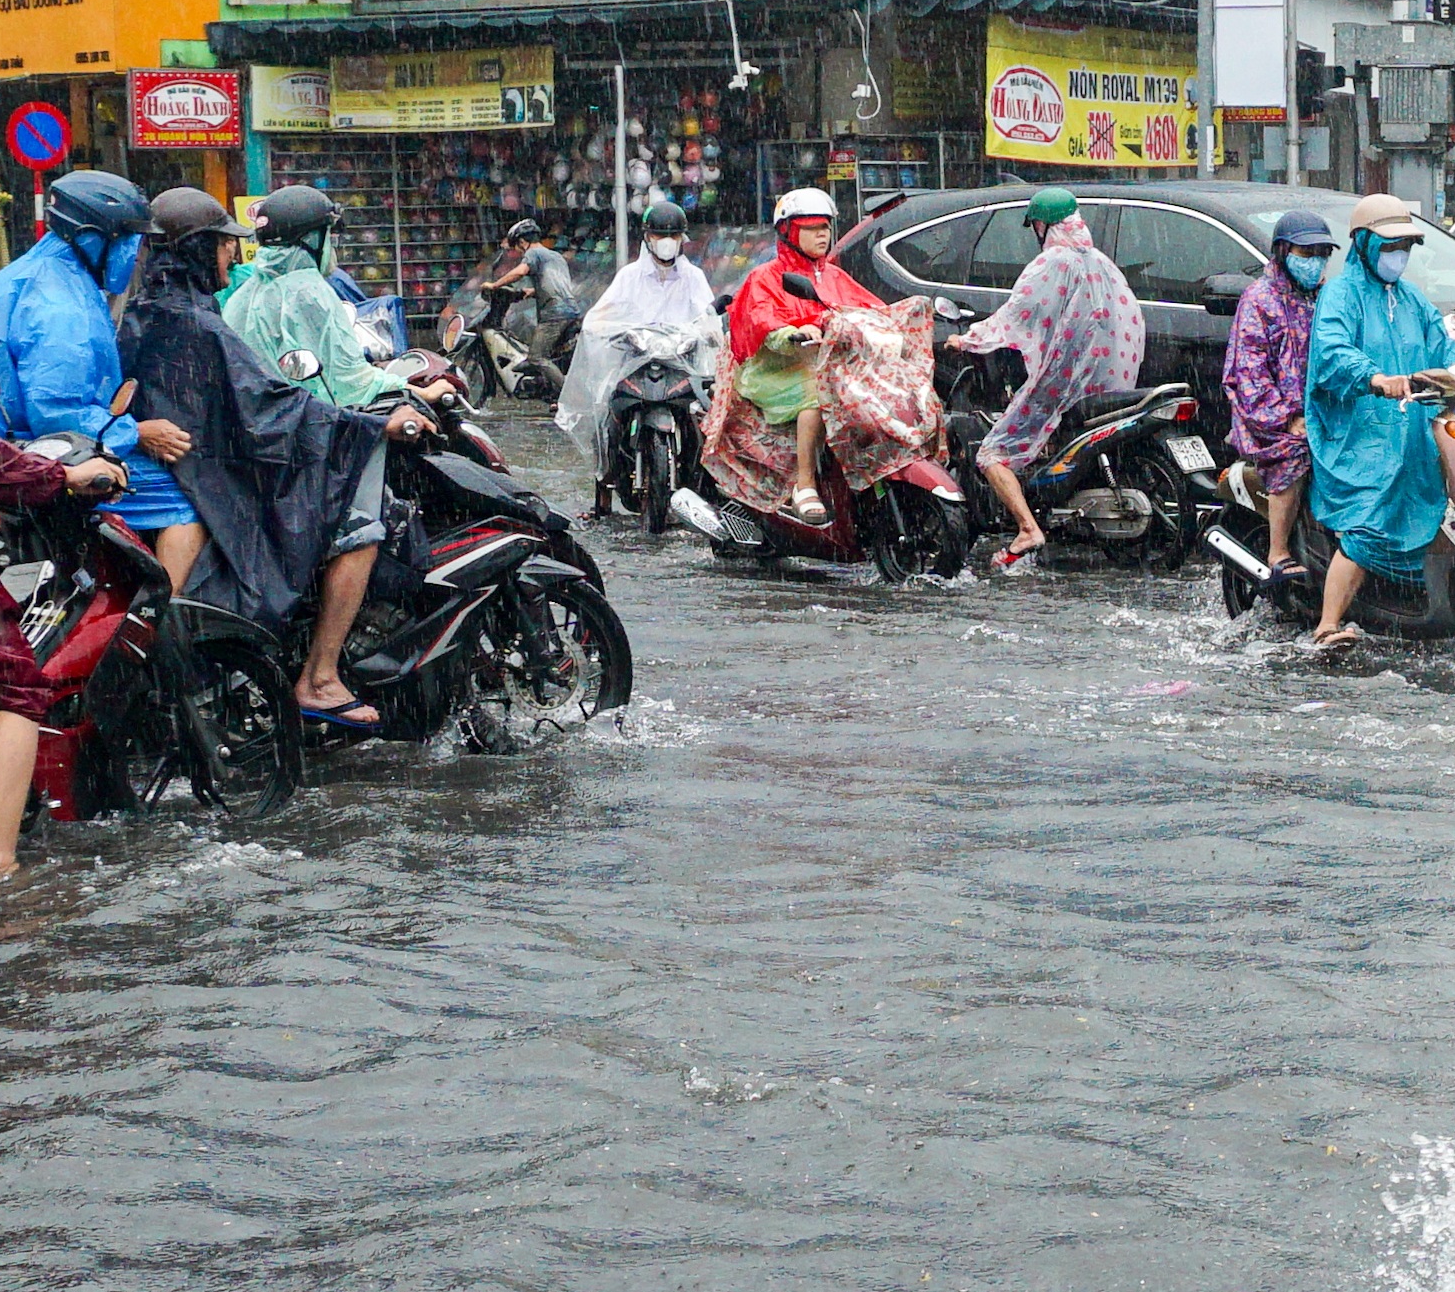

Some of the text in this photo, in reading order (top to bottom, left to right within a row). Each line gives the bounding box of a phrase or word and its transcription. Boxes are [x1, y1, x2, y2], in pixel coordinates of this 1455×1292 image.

[1068, 65, 1179, 104] NÓN ROYAL M139
[146, 95, 228, 116] HOÀNG DANH
